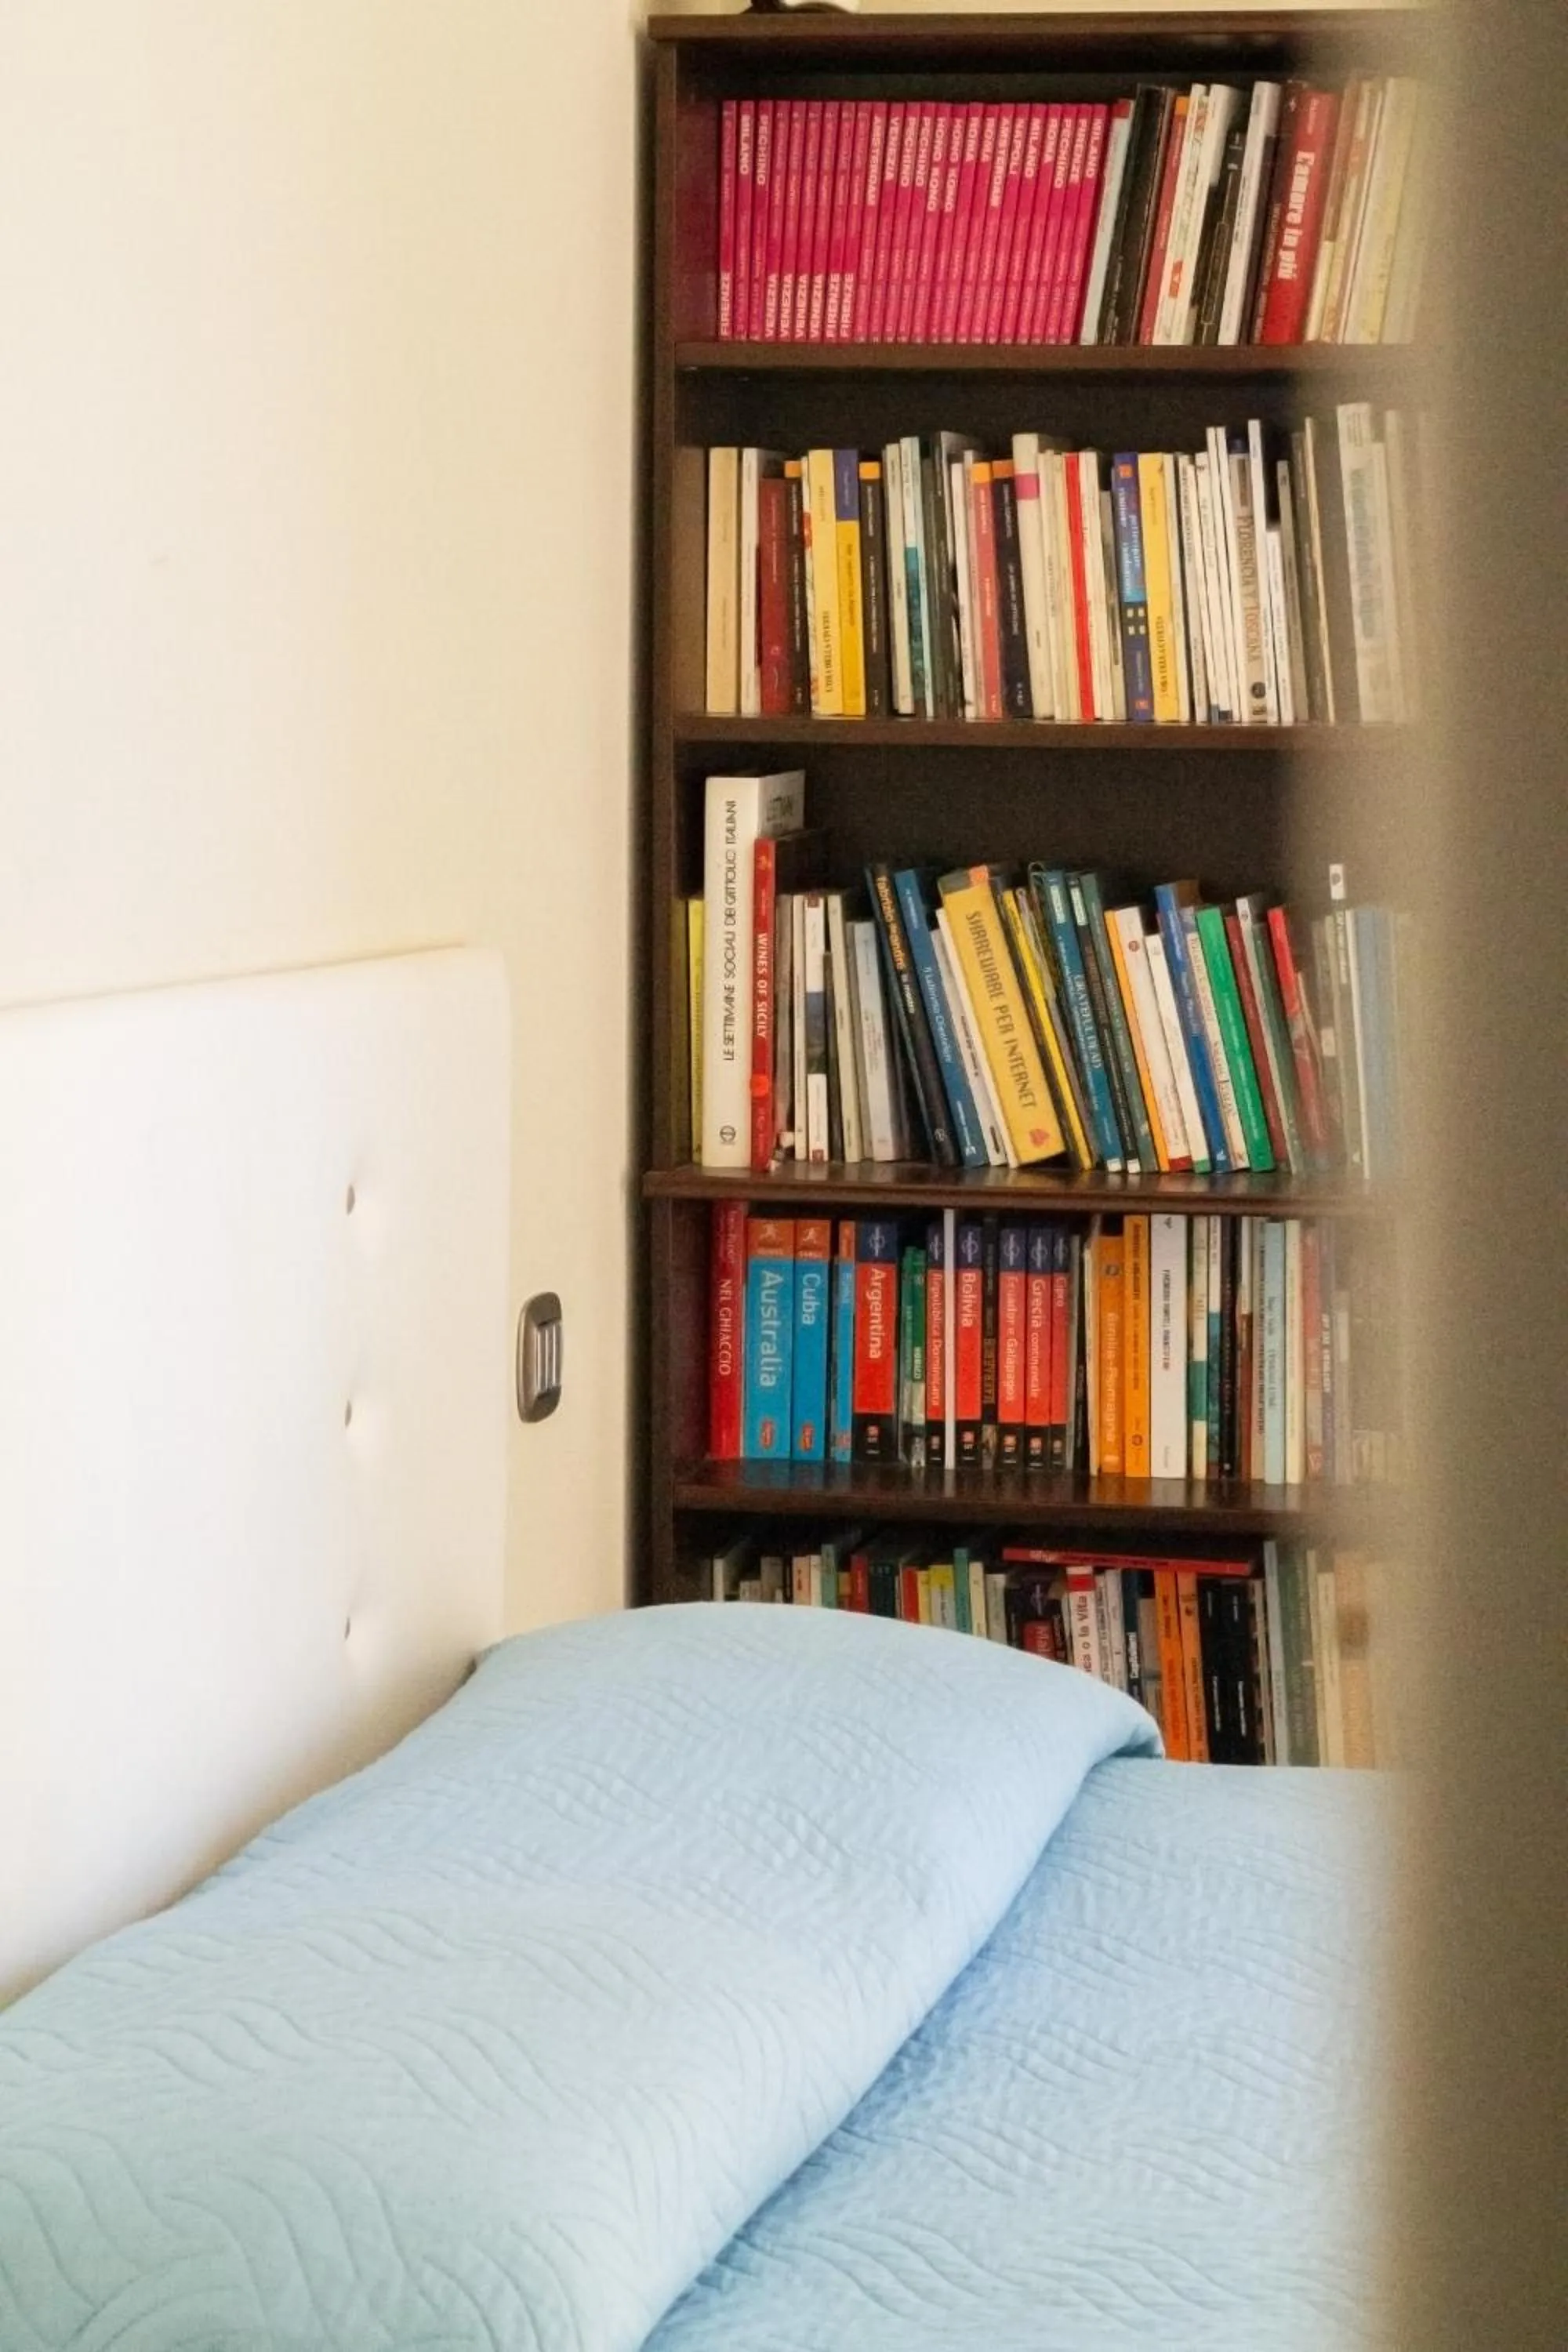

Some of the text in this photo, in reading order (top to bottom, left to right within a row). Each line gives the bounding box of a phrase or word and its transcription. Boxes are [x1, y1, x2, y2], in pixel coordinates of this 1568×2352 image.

[740, 114, 750, 175] MILANO
[757, 114, 769, 185] PECHINO
[866, 115, 882, 205] AMSTERDAM
[884, 117, 900, 181] VENEZIA
[901, 117, 916, 188] PECHINO
[915, 117, 931, 188] PECHINO
[927, 117, 946, 212] HONG KONG
[944, 118, 964, 213] HONG KONG
[965, 117, 979, 163] ROMA
[981, 117, 996, 163] ROMA
[990, 118, 1010, 207] AMSTERDAM
[1009, 118, 1025, 176] NAPOLI
[1025, 118, 1041, 179] MILANO
[1044, 118, 1058, 164] ROMA
[1054, 118, 1072, 189] PECHINO
[1069, 118, 1087, 185] FIRENZE
[1086, 118, 1102, 179] MILANO
[720, 272, 731, 336] FIRENZE
[764, 273, 778, 338] VENEZIA
[780, 273, 793, 338] VENEZIA
[794, 273, 808, 339] VENEZIA
[810, 273, 823, 338] VENEZIA
[826, 272, 840, 338] FIRENZE
[840, 272, 854, 338] FIRENZE
[1237, 514, 1261, 662] FLORENCIA Y TOSCANA
[723, 800, 736, 1061] LE SETTIMANE SOCIALI DEI CATTOLICI ITALIANI
[877, 877, 895, 923] fabrizio
[757, 932, 768, 1039] WINES OF SICILY
[965, 910, 1005, 1001] SHAREWARE
[993, 1004, 1014, 1035] PER
[1004, 1036, 1037, 1109] INTERNET
[1073, 974, 1094, 1035] GRATEFUL
[719, 1279, 731, 1303] NEL
[801, 1272, 821, 1325] Cuba
[866, 1268, 886, 1359] Argentina
[961, 1272, 976, 1328] Bolivia
[1006, 1276, 1018, 1323] Ecuador
[1053, 1276, 1068, 1308] Cipro
[718, 1306, 731, 1376] GHIACCIO
[759, 1269, 784, 1387] Australia
[931, 1273, 943, 1406] Repubblica Dominicana
[1029, 1279, 1045, 1399] Grecia continentale
[1105, 1312, 1119, 1443] Emilia-Romagna
[1076, 1595, 1089, 1621] Vita
[1078, 1625, 1090, 1637] la
[1082, 1641, 1091, 1650] o
